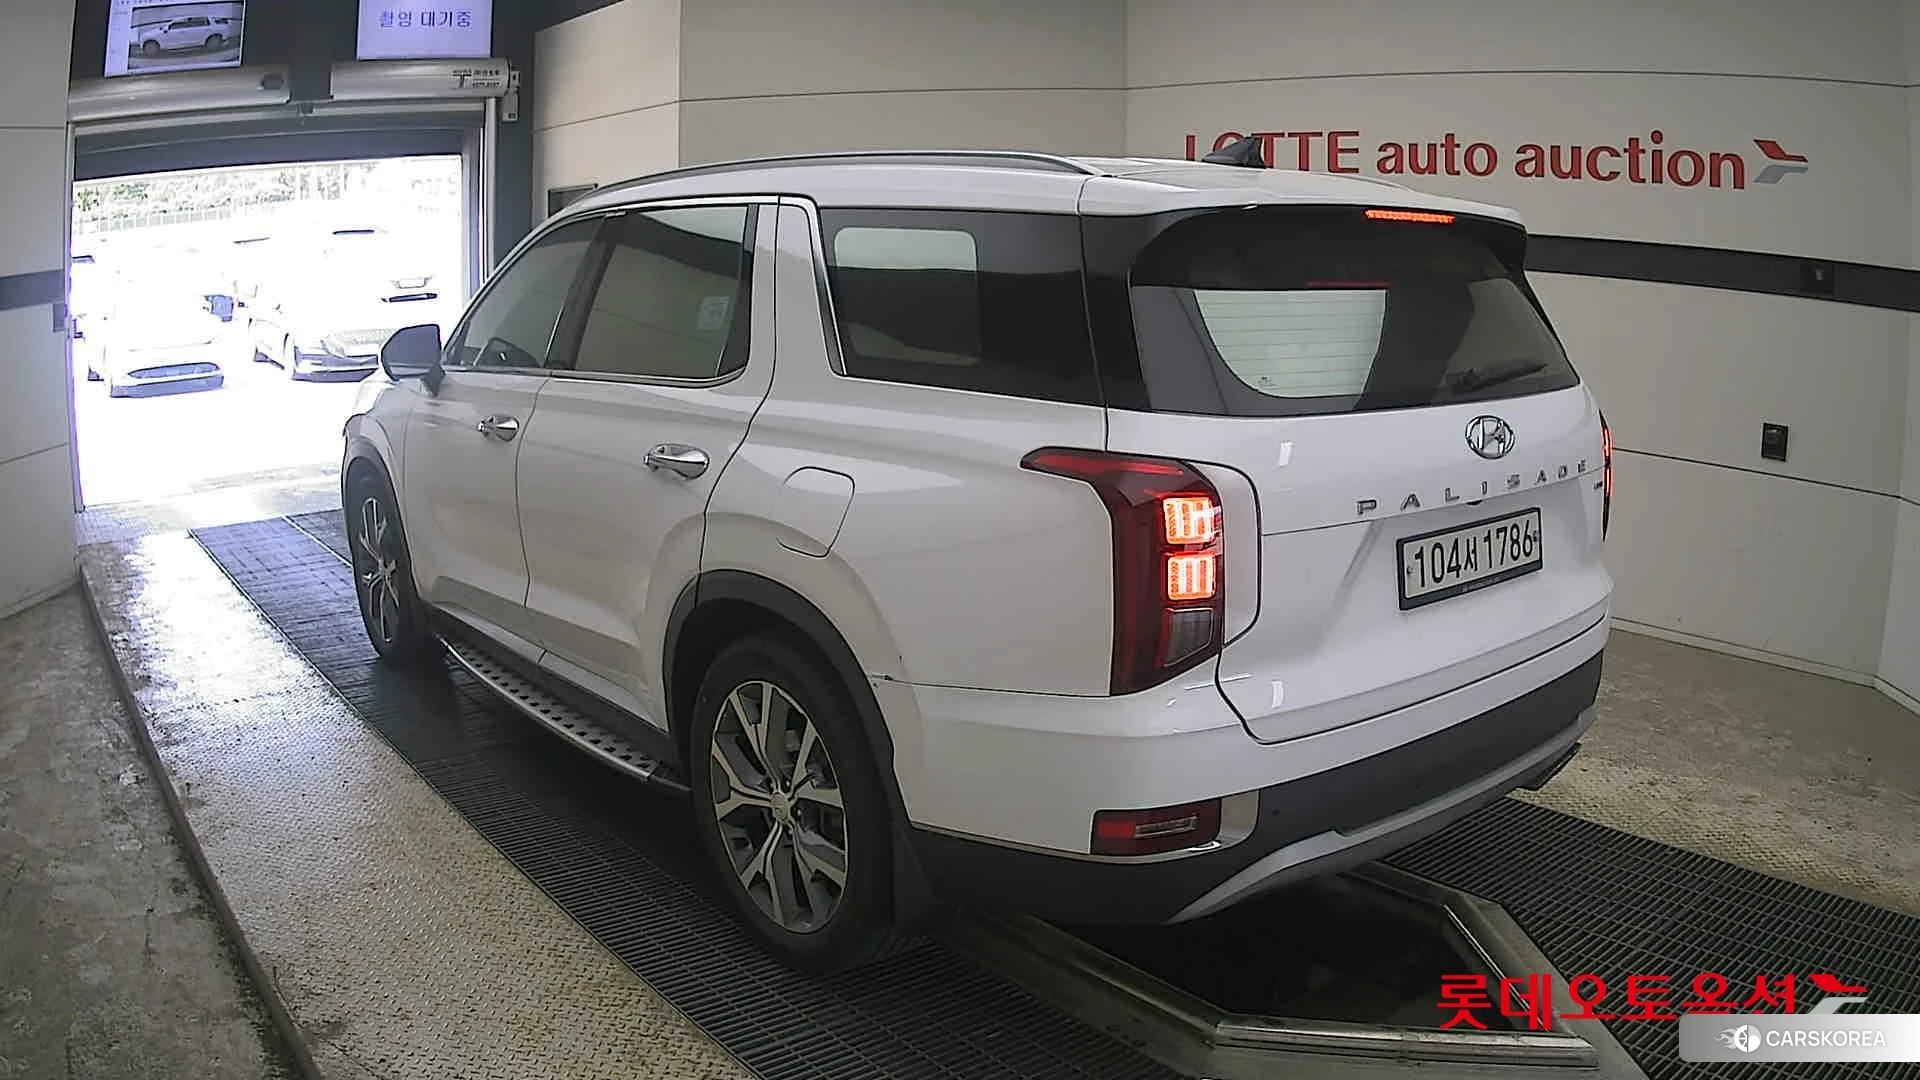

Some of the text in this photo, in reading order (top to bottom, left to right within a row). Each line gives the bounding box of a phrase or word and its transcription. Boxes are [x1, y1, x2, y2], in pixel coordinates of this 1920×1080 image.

[420, 10, 472, 28] 대기중
[1376, 133, 1498, 177] auto
[1515, 130, 1745, 190] auction
[1356, 459, 1587, 516] PALISADE
